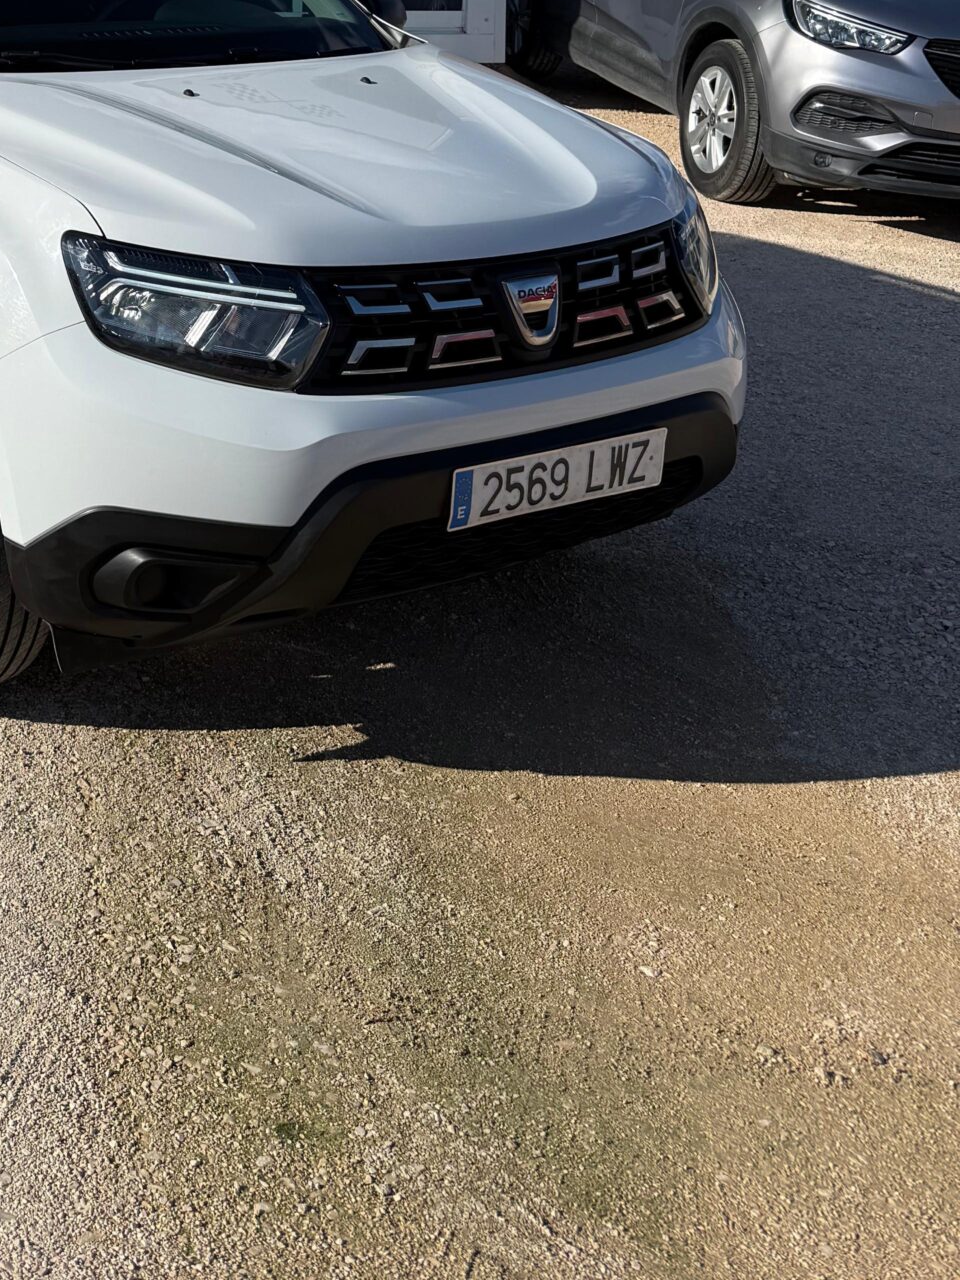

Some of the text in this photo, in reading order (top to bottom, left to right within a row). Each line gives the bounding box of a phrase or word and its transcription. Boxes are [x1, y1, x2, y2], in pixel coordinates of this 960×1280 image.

[517, 285, 554, 299] DACIA
[479, 439, 650, 517] 2569 LWZ
[457, 506, 466, 519] E
